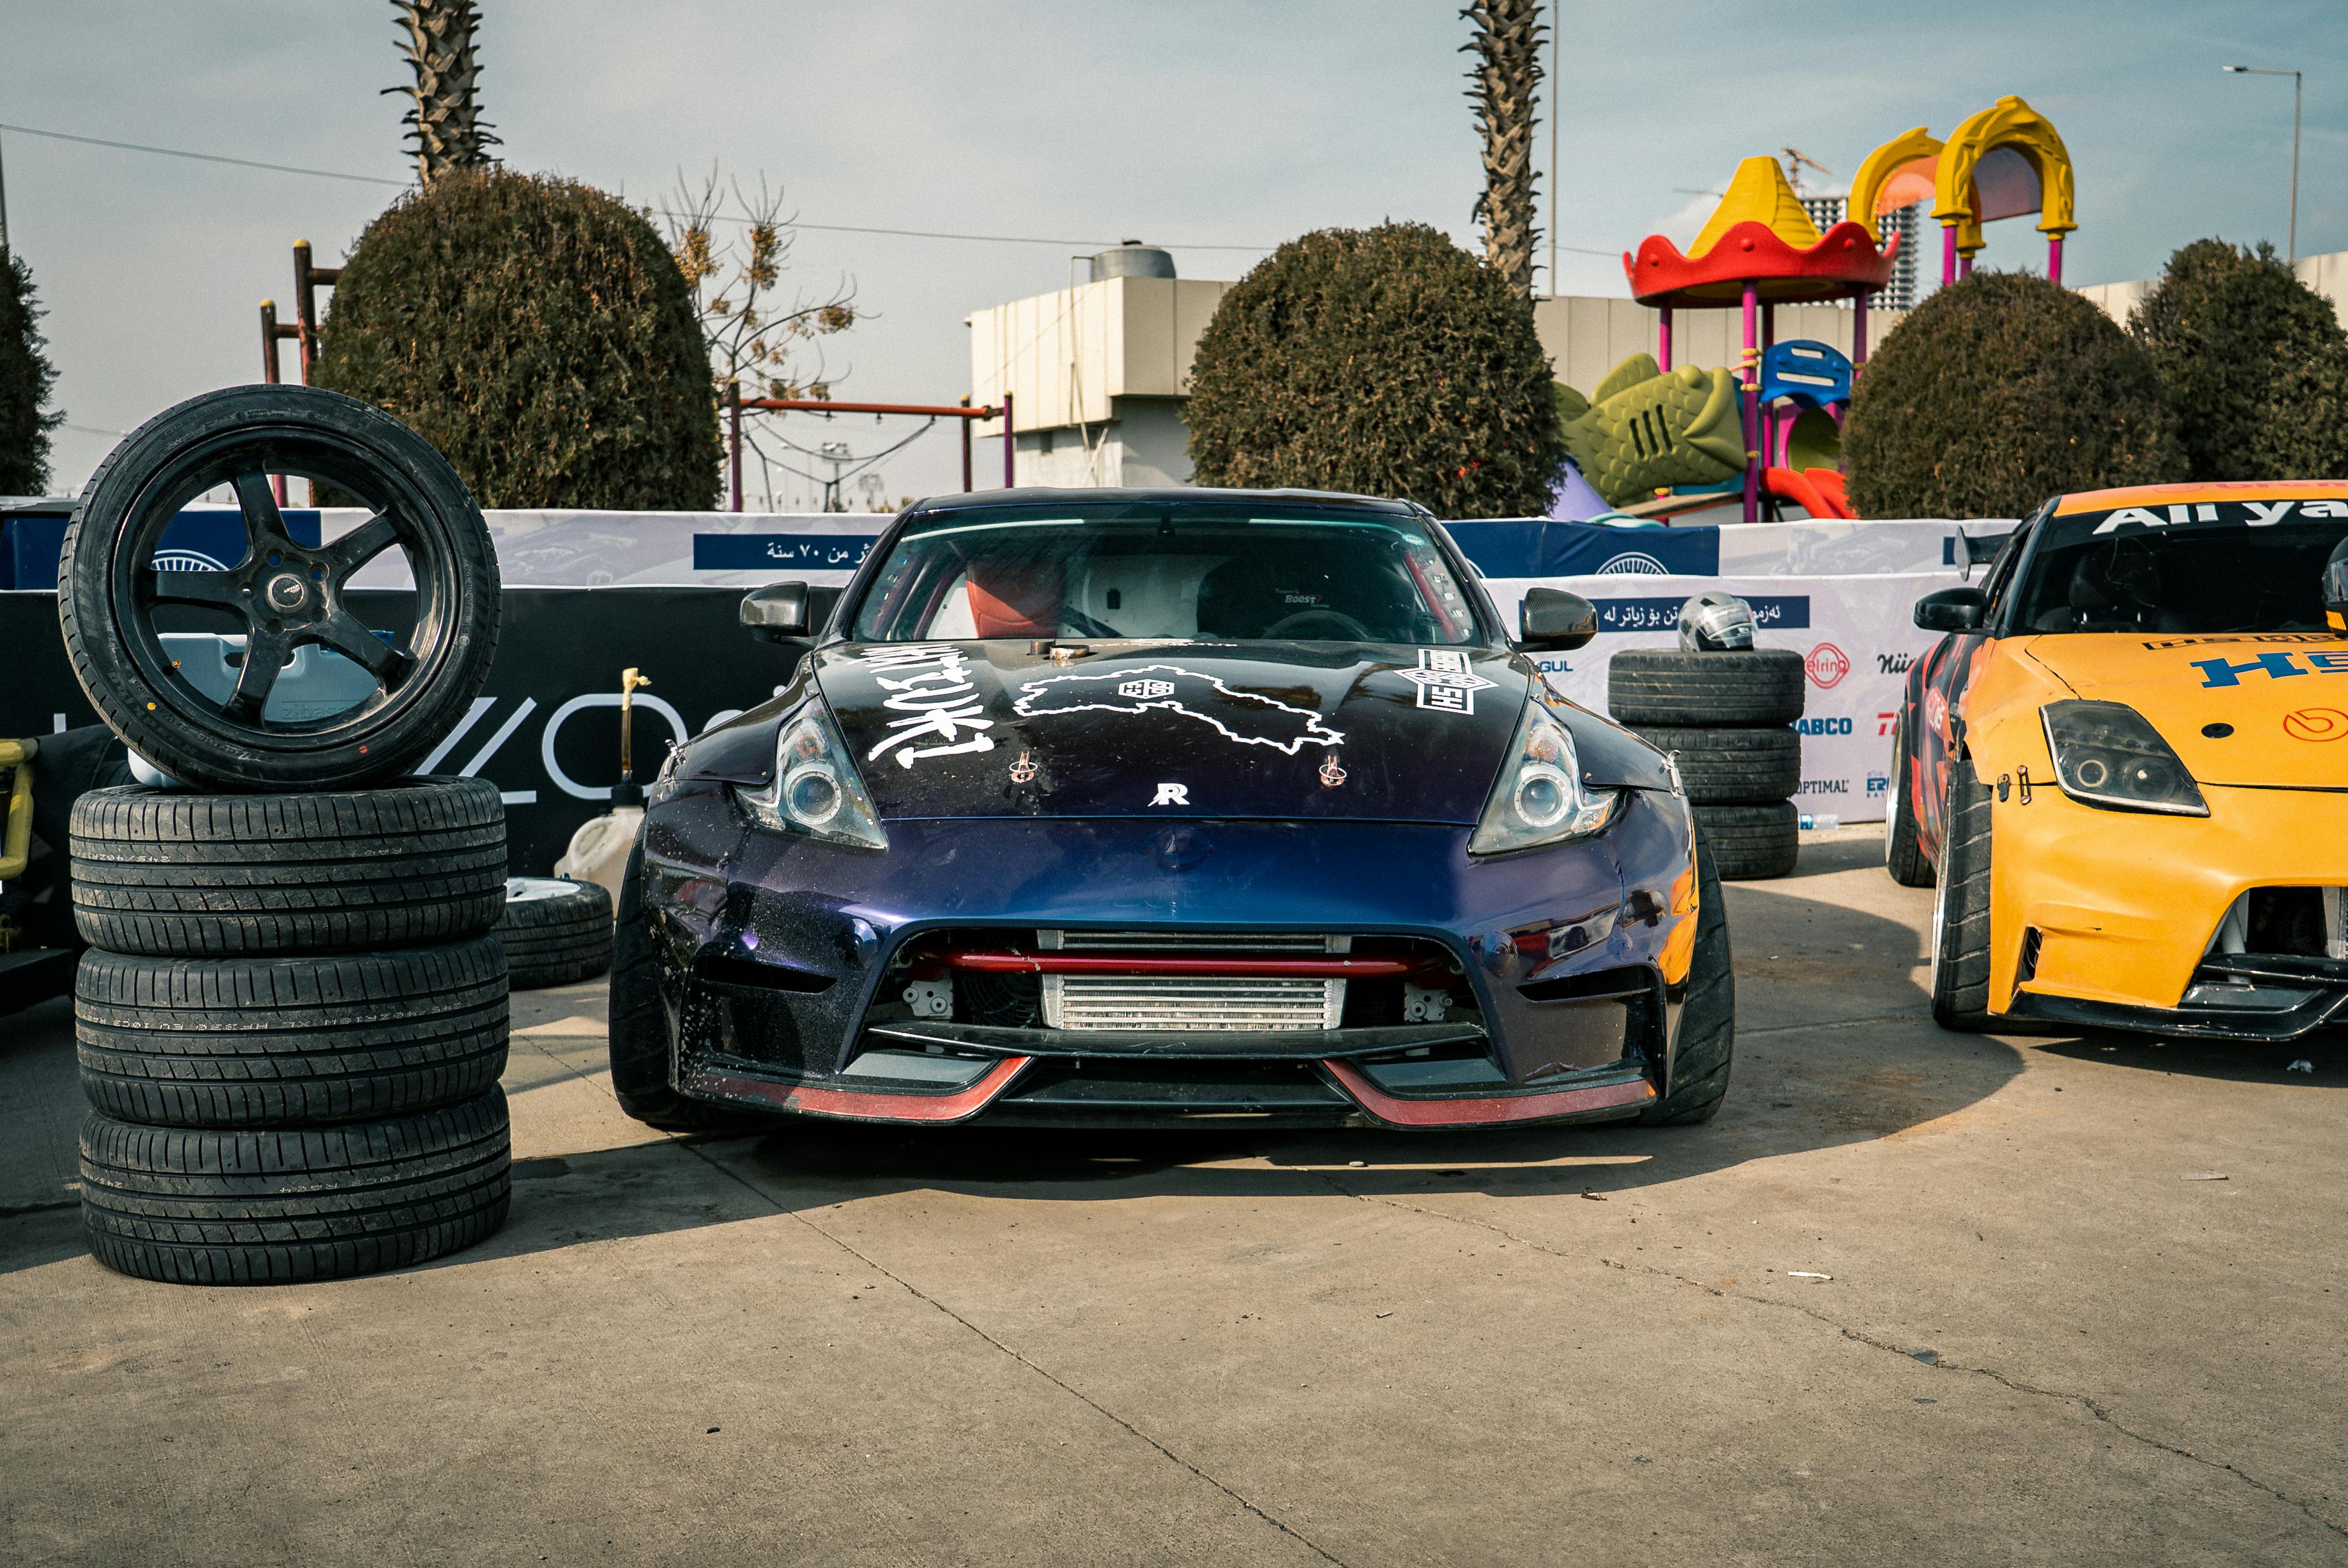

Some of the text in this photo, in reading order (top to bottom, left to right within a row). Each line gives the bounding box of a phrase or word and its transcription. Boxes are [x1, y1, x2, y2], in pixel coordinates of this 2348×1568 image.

[2092, 503, 2219, 535] Ali
[766, 542, 794, 558] سنة
[827, 547, 849, 564] من
[1806, 658, 1847, 673] elring
[1791, 718, 1852, 736] ABCO
